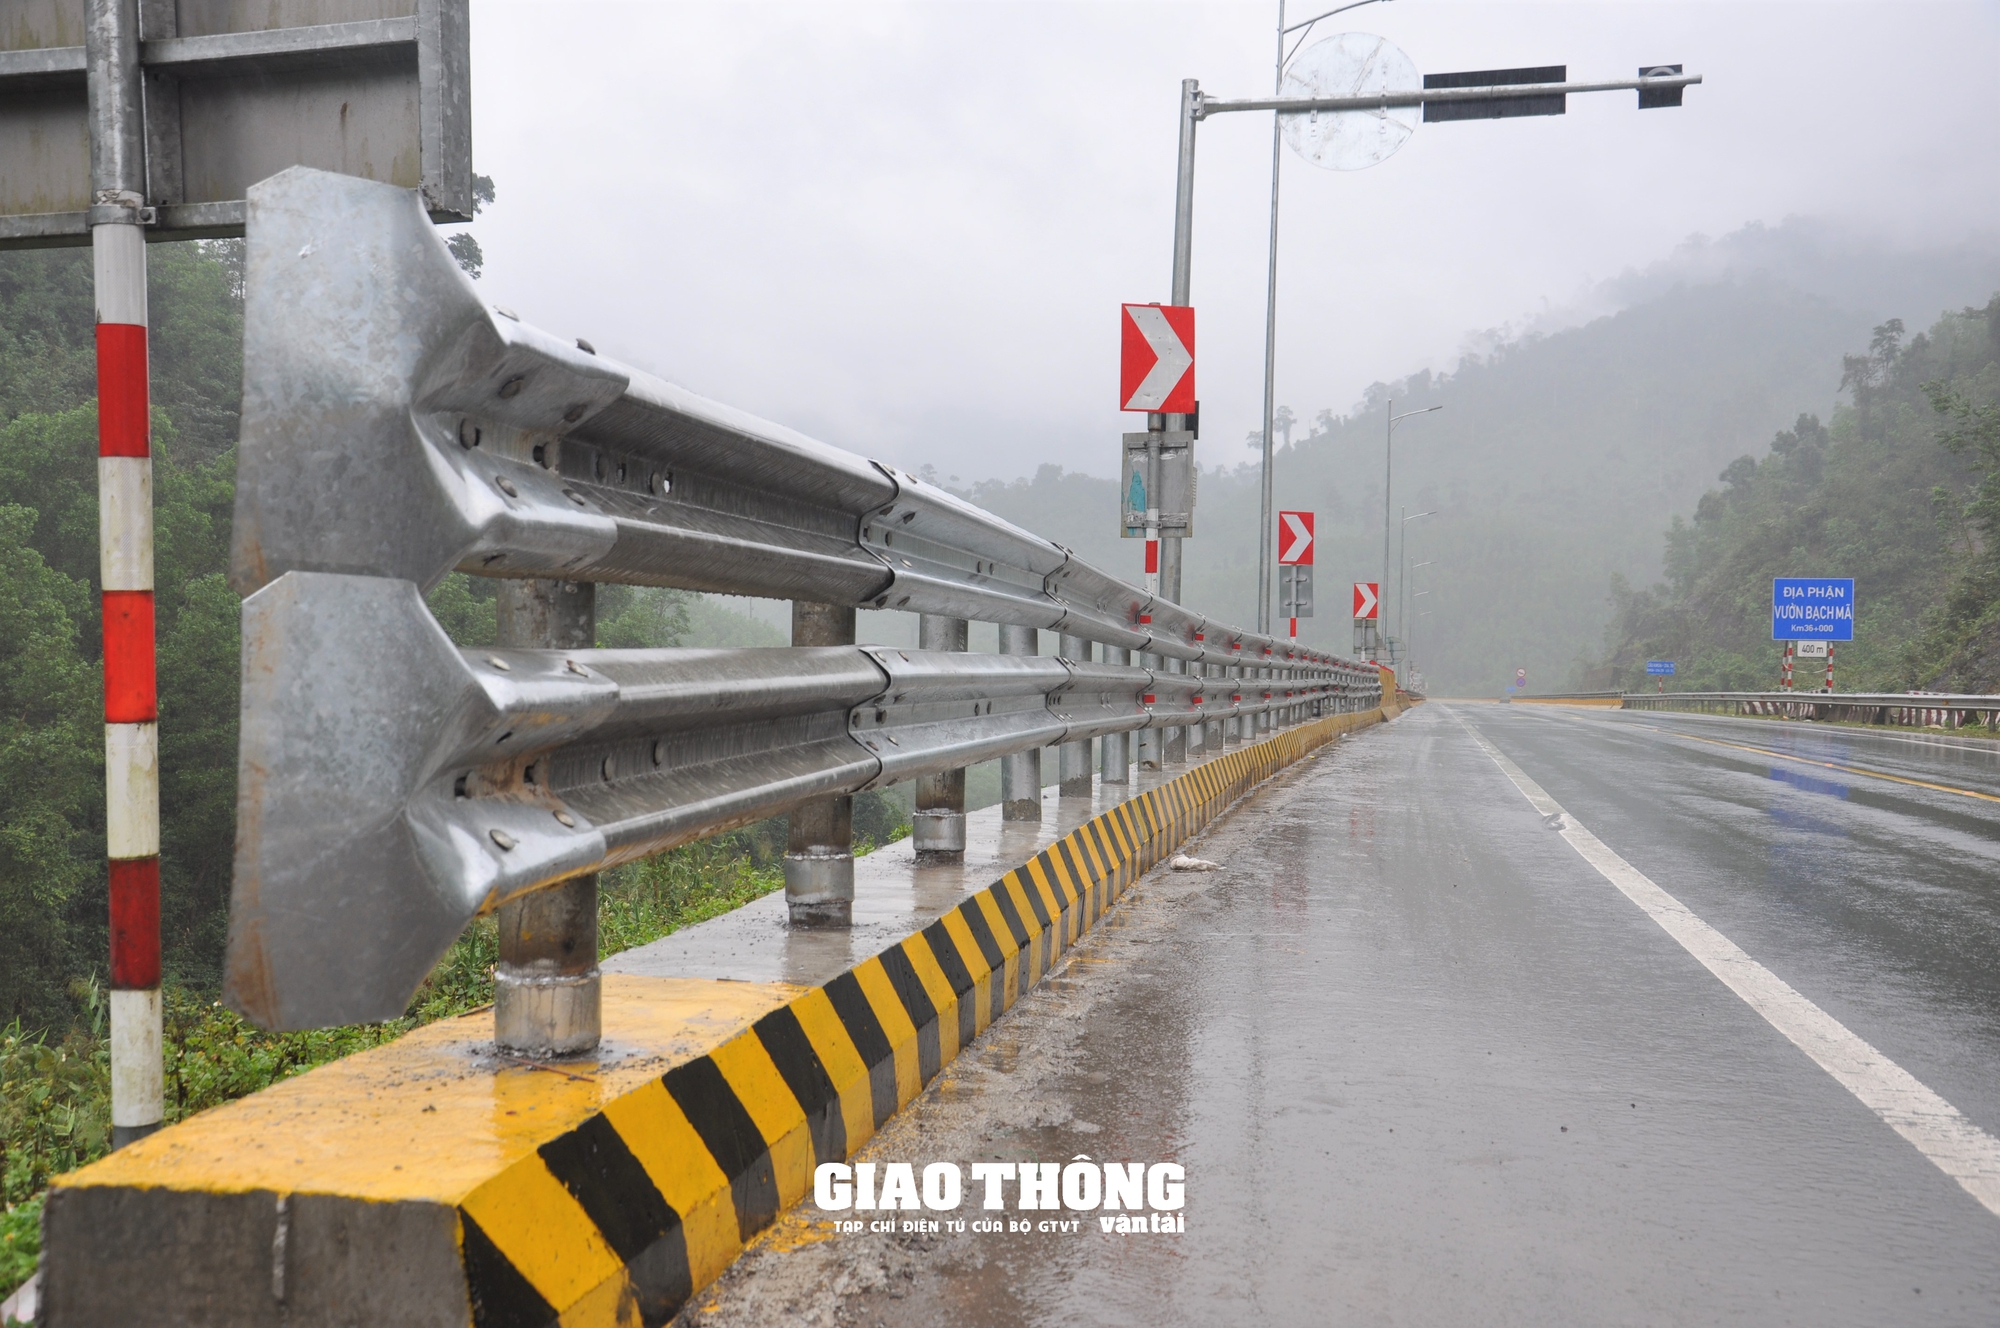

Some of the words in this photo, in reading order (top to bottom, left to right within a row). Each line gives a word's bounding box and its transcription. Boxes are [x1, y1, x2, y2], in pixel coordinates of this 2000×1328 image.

[1783, 586, 1804, 599] ĐỊA
[1807, 585, 1844, 599] PHẬN
[1774, 602, 1804, 619] VƯỜN
[1805, 605, 1834, 621] BẠCH
[1835, 603, 1852, 619] MÃ
[1791, 624, 1834, 632] Km36+000
[1802, 645, 1815, 653] 400
